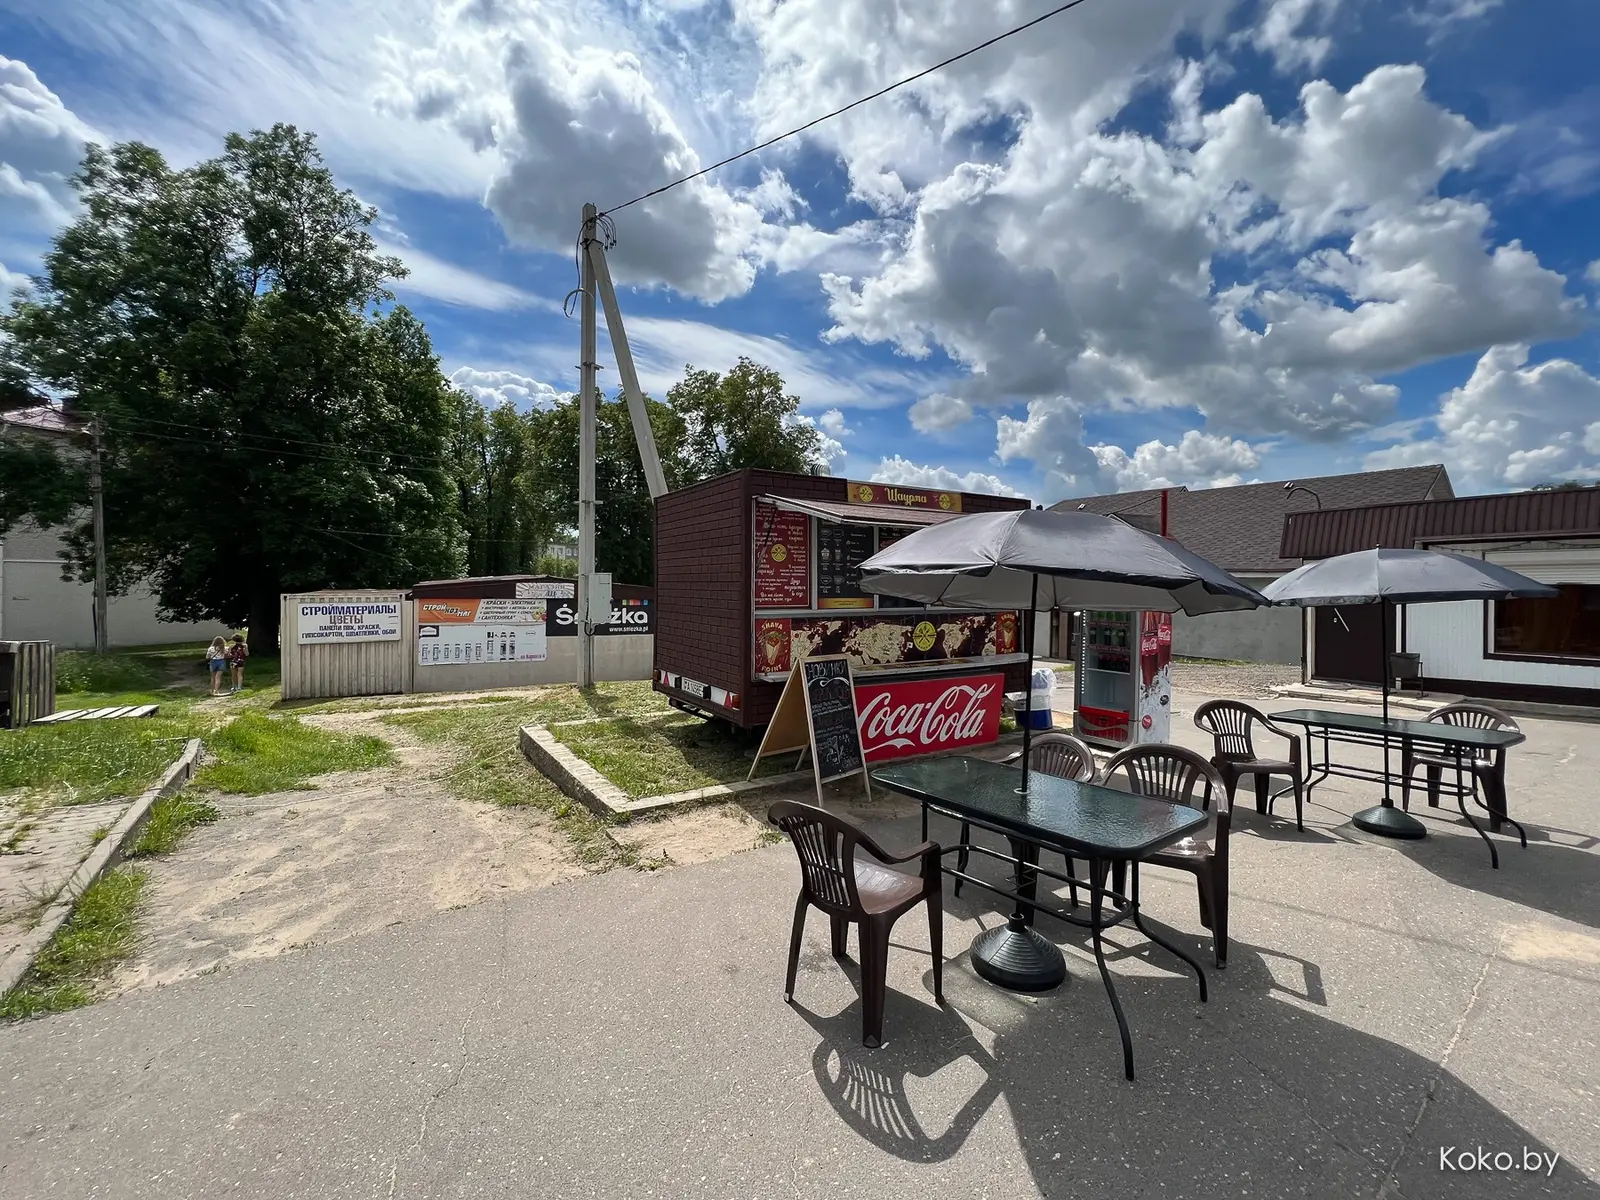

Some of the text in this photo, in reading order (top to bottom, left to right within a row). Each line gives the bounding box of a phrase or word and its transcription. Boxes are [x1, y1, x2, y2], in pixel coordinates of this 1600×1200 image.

[884, 487, 927, 506] Шаурма
[301, 604, 397, 616] СТРОЙМАТЕРИАЛЫ
[556, 603, 648, 625] Śżka
[329, 615, 364, 625] ЦВЕТЫ
[761, 622, 783, 630] SHAVA
[858, 683, 996, 745] Coca-Cola
